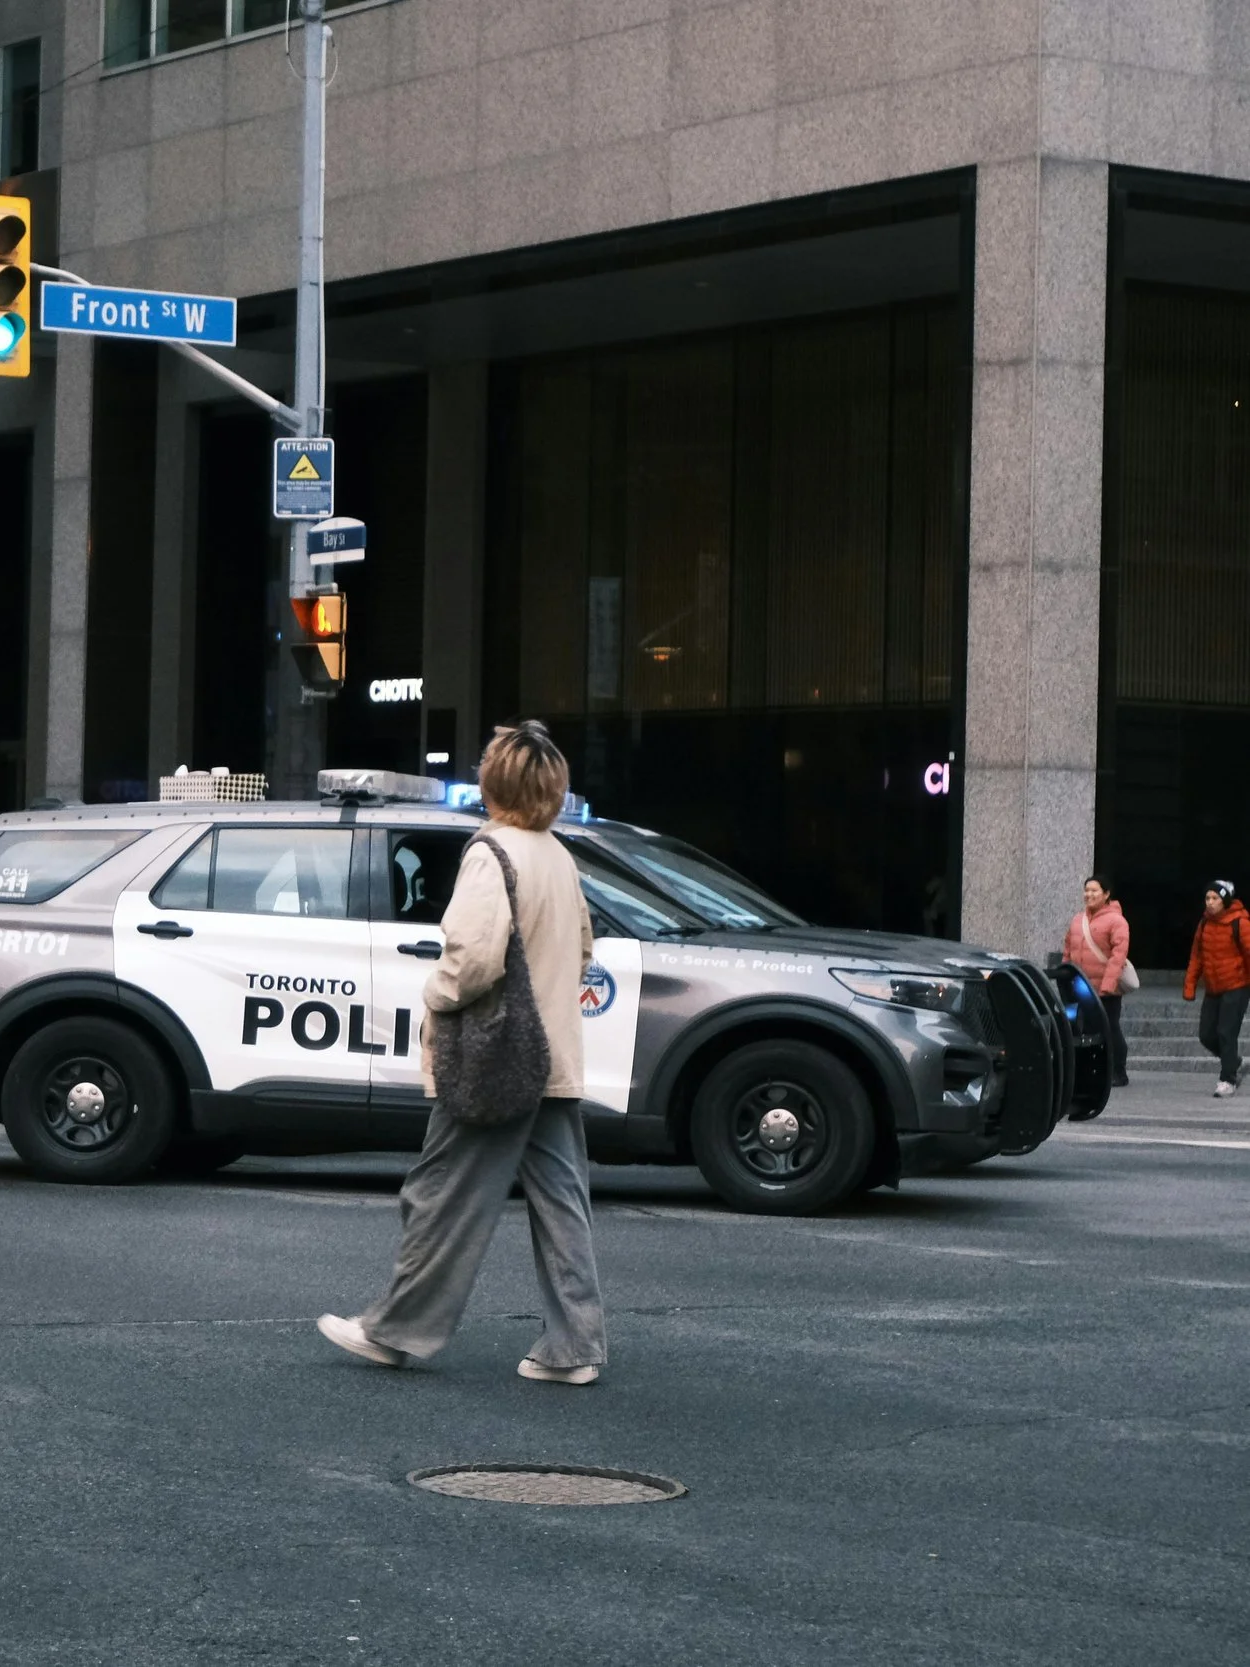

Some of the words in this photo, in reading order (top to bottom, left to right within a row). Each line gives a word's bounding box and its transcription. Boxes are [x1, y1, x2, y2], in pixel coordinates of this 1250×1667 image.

[71, 292, 150, 329] Front
[161, 300, 177, 318] St
[183, 302, 207, 333] W
[323, 531, 338, 549] Bay
[2, 868, 29, 876] CALL
[659, 952, 678, 965] To
[682, 954, 729, 969] Serve
[735, 958, 746, 969] &
[752, 959, 814, 975] Protect
[246, 973, 357, 996] TORONTO
[242, 995, 423, 1057] POLI
